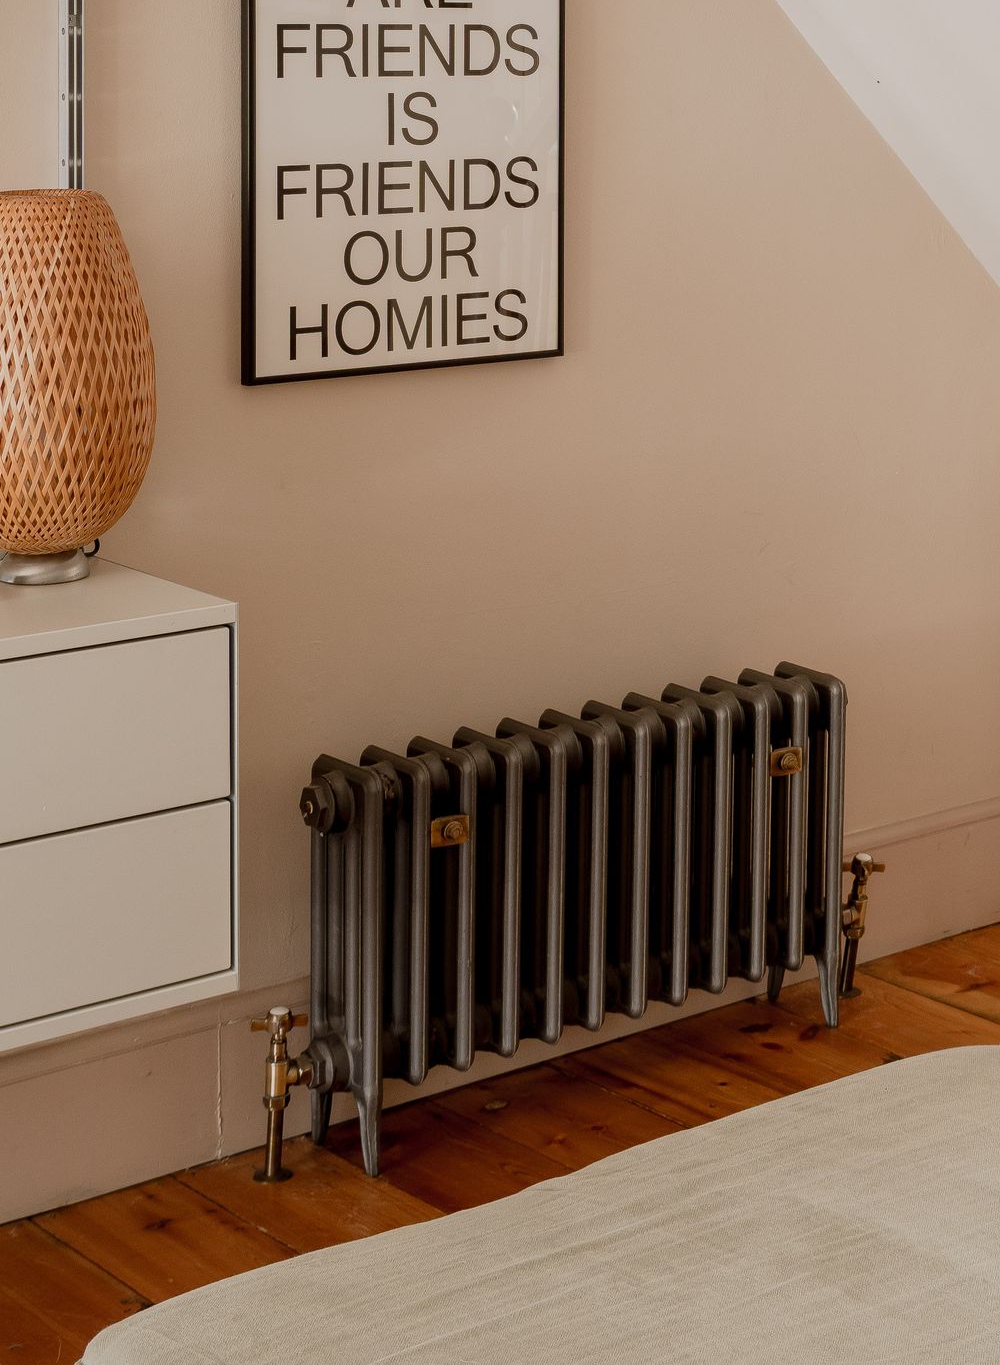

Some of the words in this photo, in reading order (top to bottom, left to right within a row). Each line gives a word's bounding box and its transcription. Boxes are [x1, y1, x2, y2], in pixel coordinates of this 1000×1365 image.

[276, 23, 541, 79] FRIENDS
[387, 91, 439, 146] IS
[276, 156, 540, 221] FRIENDS
[343, 226, 480, 286] OUR
[288, 288, 529, 362] HOMIES
